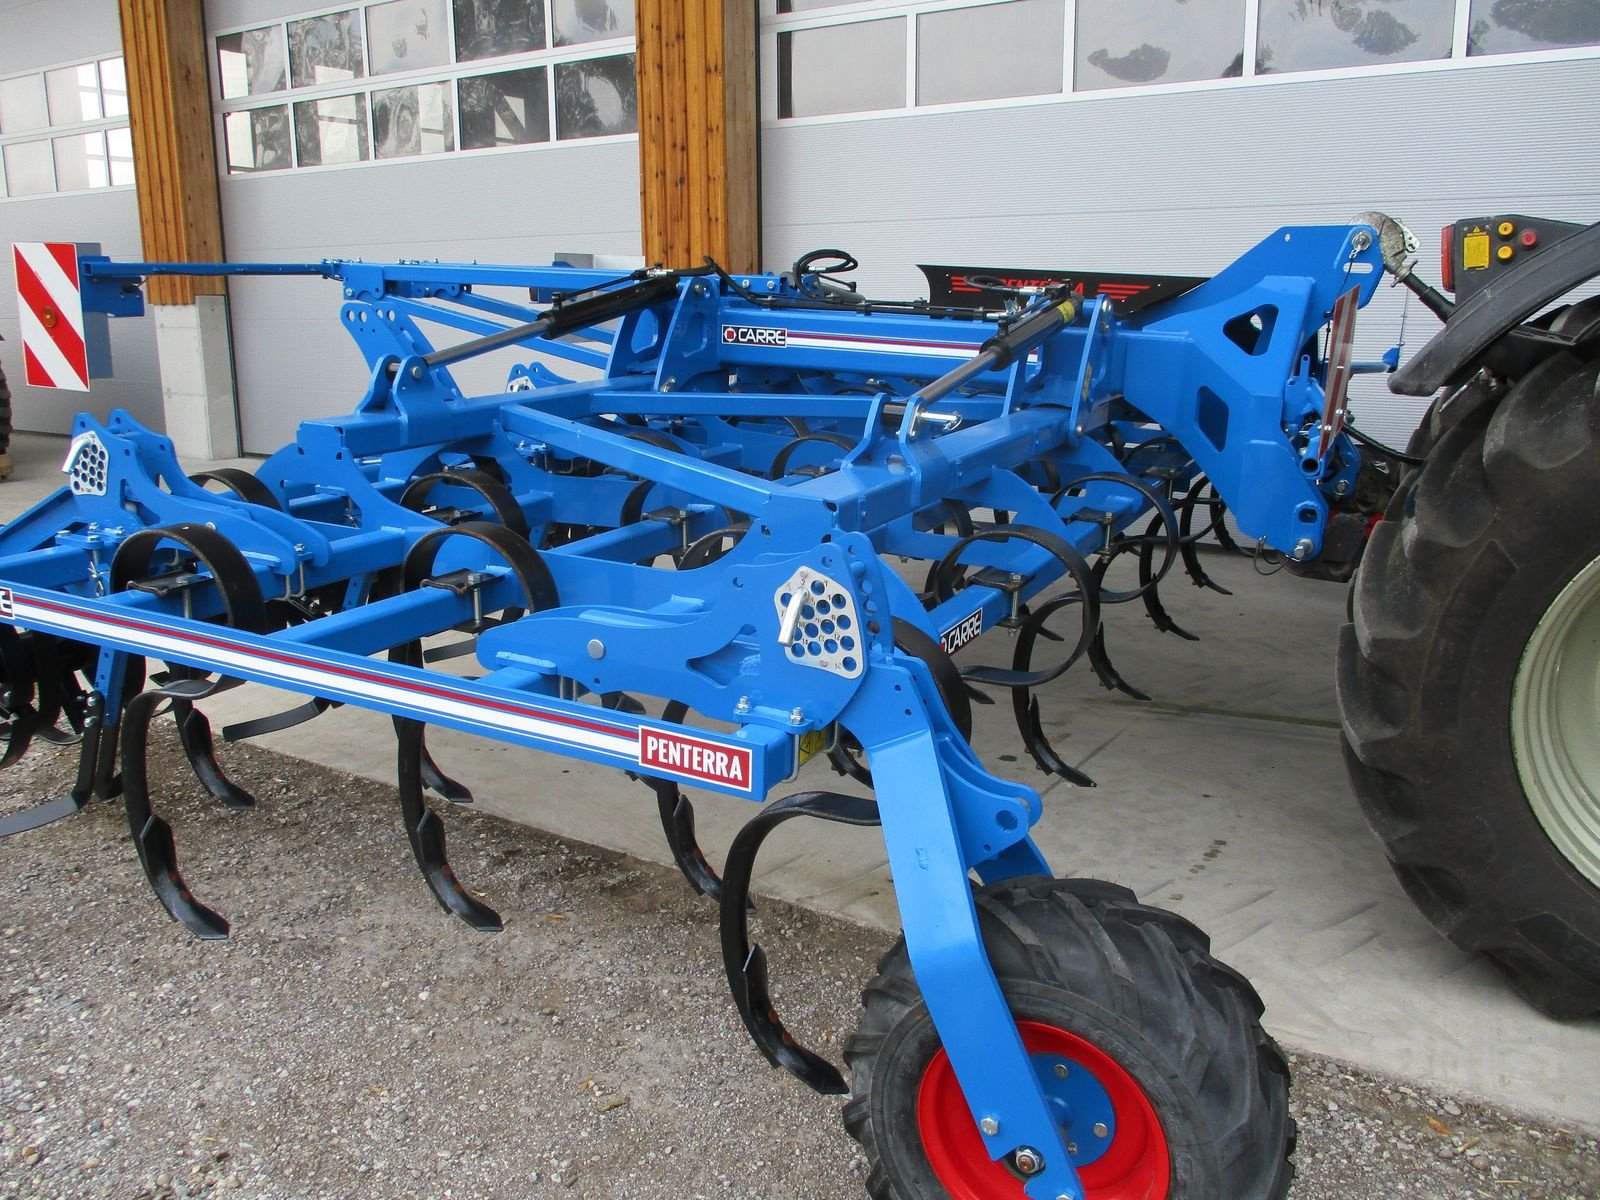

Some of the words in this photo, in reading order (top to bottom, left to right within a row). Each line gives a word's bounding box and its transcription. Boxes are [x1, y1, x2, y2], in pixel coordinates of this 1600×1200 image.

[738, 328, 785, 345] CARRE
[948, 613, 981, 654] CARRE
[647, 736, 743, 781] PENTERRA
